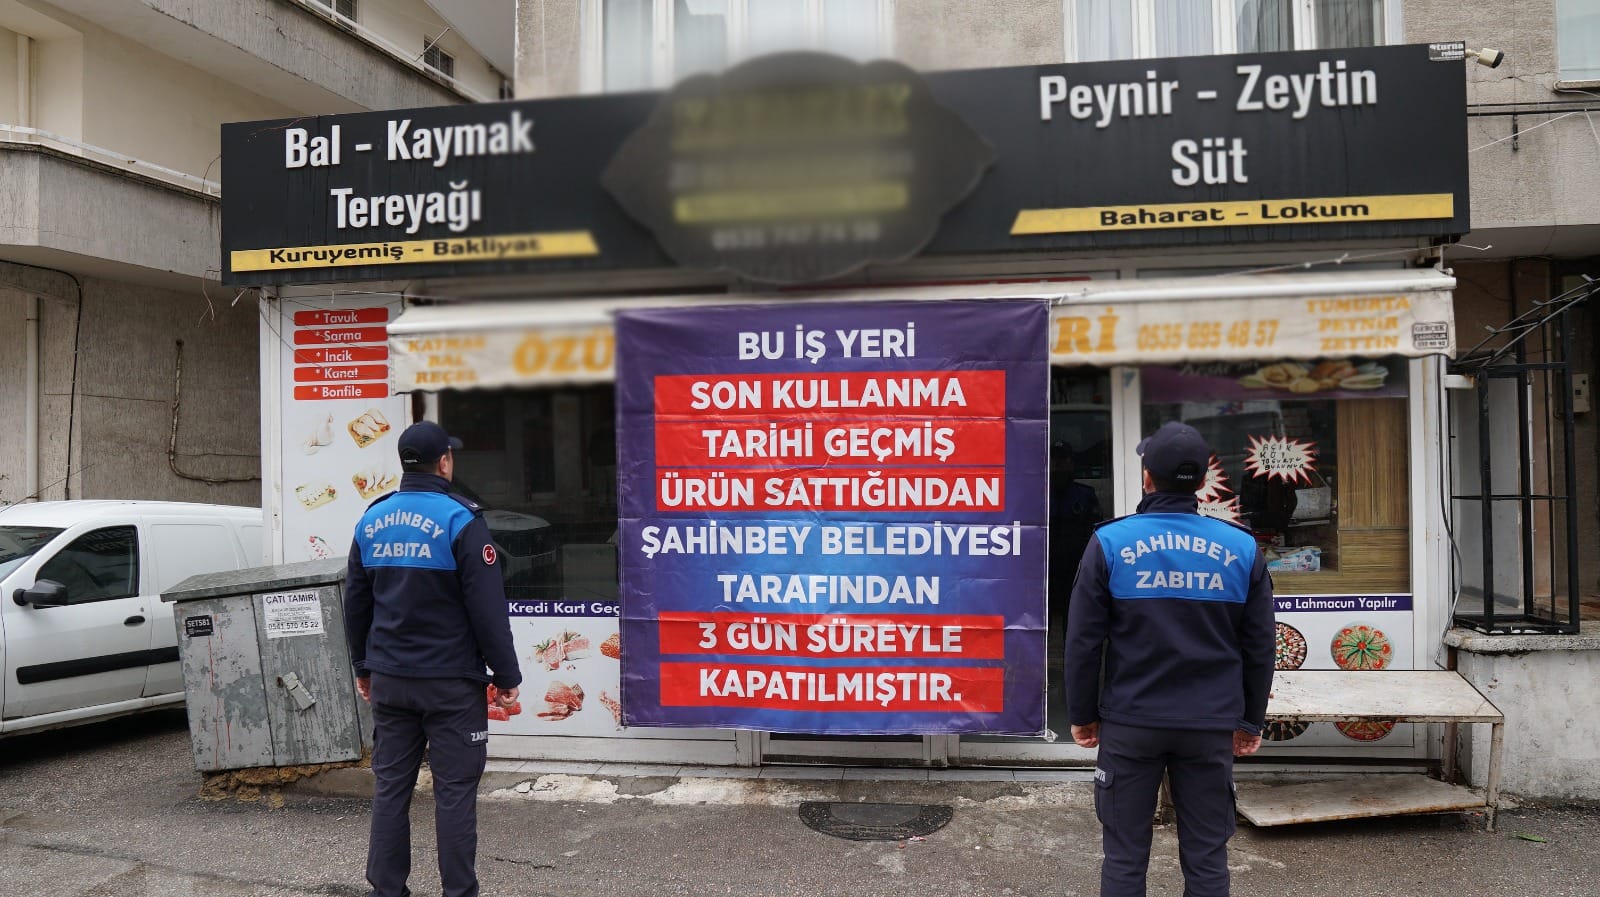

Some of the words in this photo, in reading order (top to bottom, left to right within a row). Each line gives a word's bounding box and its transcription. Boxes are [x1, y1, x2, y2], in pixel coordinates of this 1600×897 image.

[1039, 70, 1179, 128] Peynir
[1197, 89, 1217, 100] -
[1236, 59, 1377, 118] Zeytin
[285, 124, 341, 168] Bal
[354, 142, 373, 153] -
[387, 110, 535, 167] Kaymak
[1171, 137, 1248, 186] Süt
[330, 180, 482, 234] Tereyağı
[1100, 207, 1224, 227] Baharat
[1261, 200, 1370, 220] Lokum
[269, 243, 404, 265] Kuruyemiş
[433, 237, 541, 257] Bakliyat
[323, 312, 358, 323] Tavuk
[1255, 318, 1280, 348] 57
[324, 330, 362, 341] Sarma
[738, 331, 784, 361] BU
[795, 324, 826, 364] İŞ
[835, 322, 915, 358] YERİ
[325, 349, 352, 362] İncik
[324, 367, 358, 379] Kanat
[322, 385, 362, 397] Bonfile
[691, 380, 762, 410] SON
[772, 377, 967, 408] KULLANMA
[702, 423, 813, 457] TARİHİ
[824, 422, 955, 463] GEÇMİŞ
[661, 472, 754, 507] ÜRÜN
[764, 471, 1000, 507] SATTIĞINDAN
[364, 508, 446, 540] ŞAHİNBEY
[641, 520, 811, 559] ŞAHİNBEY
[821, 520, 1021, 557] BELEDİYESİ
[372, 542, 432, 559] ZABITA
[1120, 531, 1238, 567] ŞAHİNBEY
[717, 574, 940, 605] TARAFINDAN
[1135, 571, 1225, 591] ZABITA
[265, 595, 285, 605] ÇATI
[508, 602, 548, 613] Kredi
[554, 602, 586, 613] Kart
[1278, 601, 1292, 609] ve
[1295, 598, 1355, 609] Lahmacun
[1358, 597, 1397, 610] Yapılır
[698, 622, 716, 649] 3
[727, 616, 797, 652] GÜN
[806, 617, 962, 653] SÜREYLE
[700, 669, 962, 707] KAPATILMIŞTIR.
